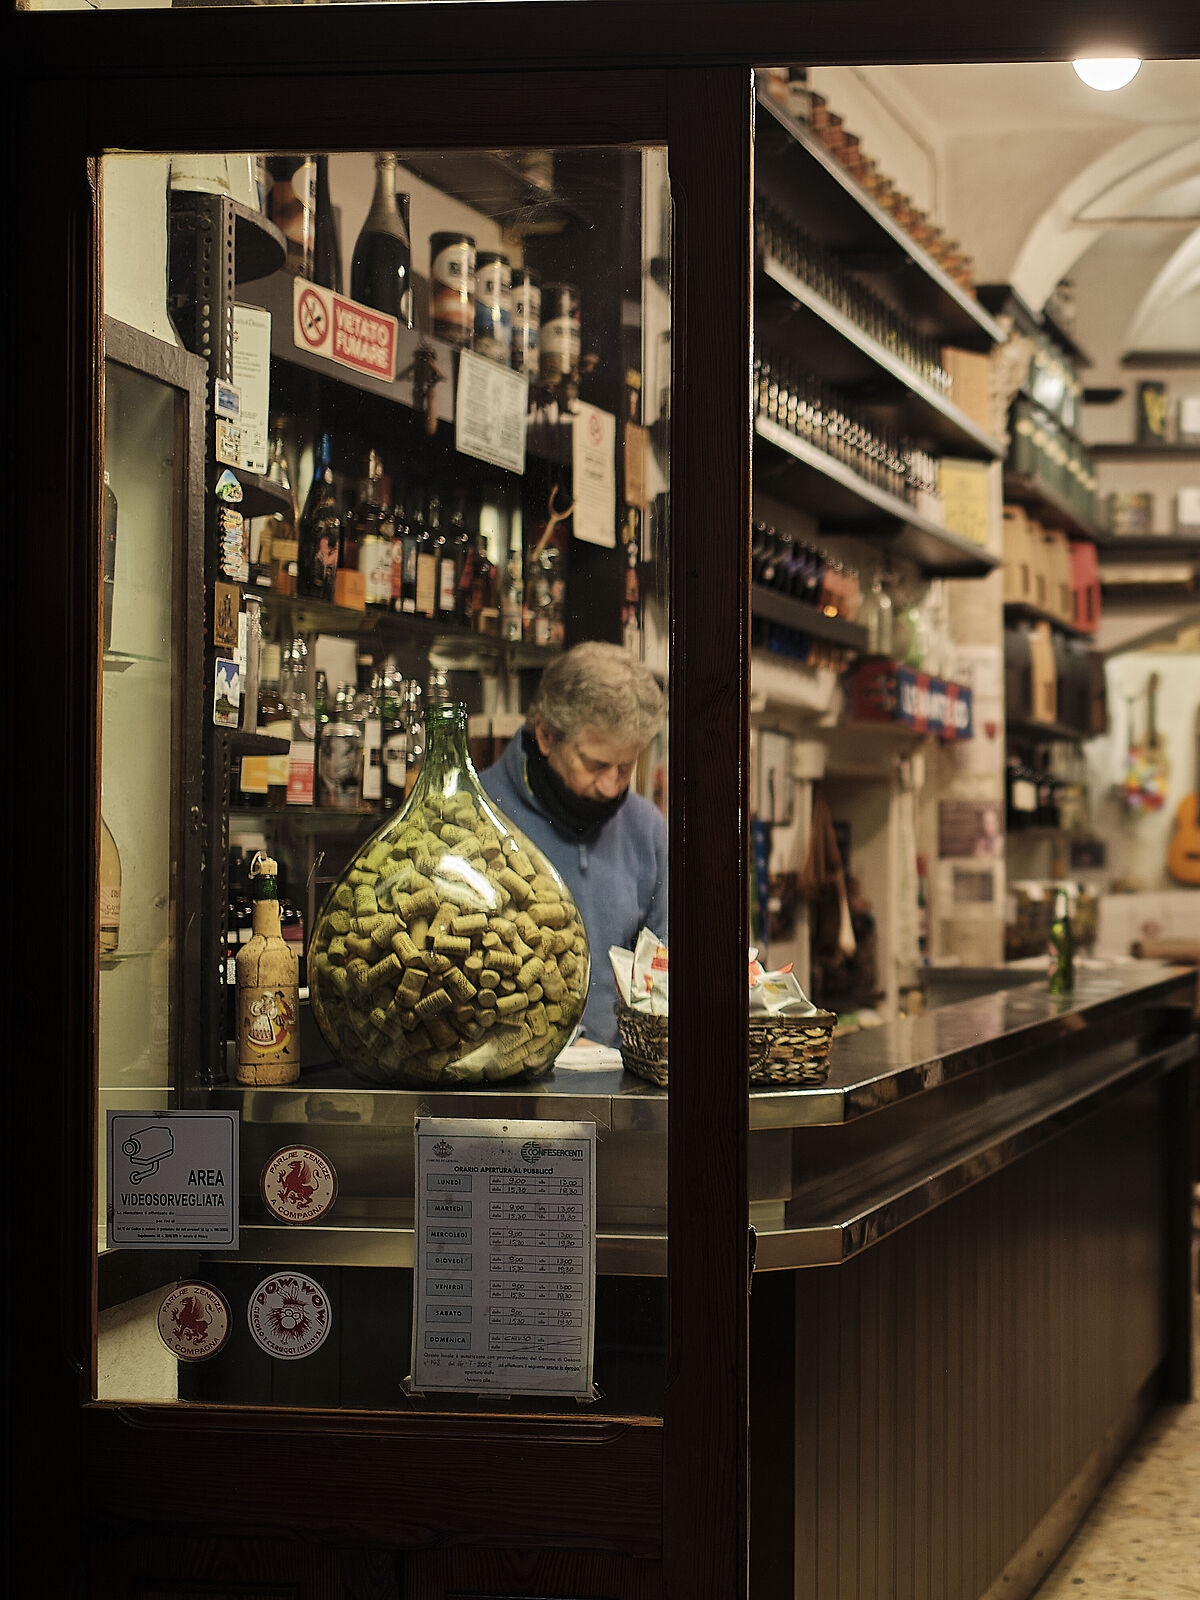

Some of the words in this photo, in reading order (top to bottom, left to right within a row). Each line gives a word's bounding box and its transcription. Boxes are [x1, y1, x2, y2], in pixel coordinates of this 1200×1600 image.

[336, 330, 389, 369] FUMARE
[303, 1152, 331, 1180] ZENEIZE
[523, 1167, 554, 1175] PUBBLICO
[187, 1169, 225, 1187] AREA
[437, 1178, 461, 1186] LUNEDÌ
[120, 1193, 225, 1207] VIDEOSORVEGLIATA
[278, 1204, 324, 1219] COMPAGNA
[194, 1288, 224, 1314] ZENEIZE
[175, 1337, 220, 1354] COMPAGNA
[430, 1336, 466, 1344] DOMENICA
